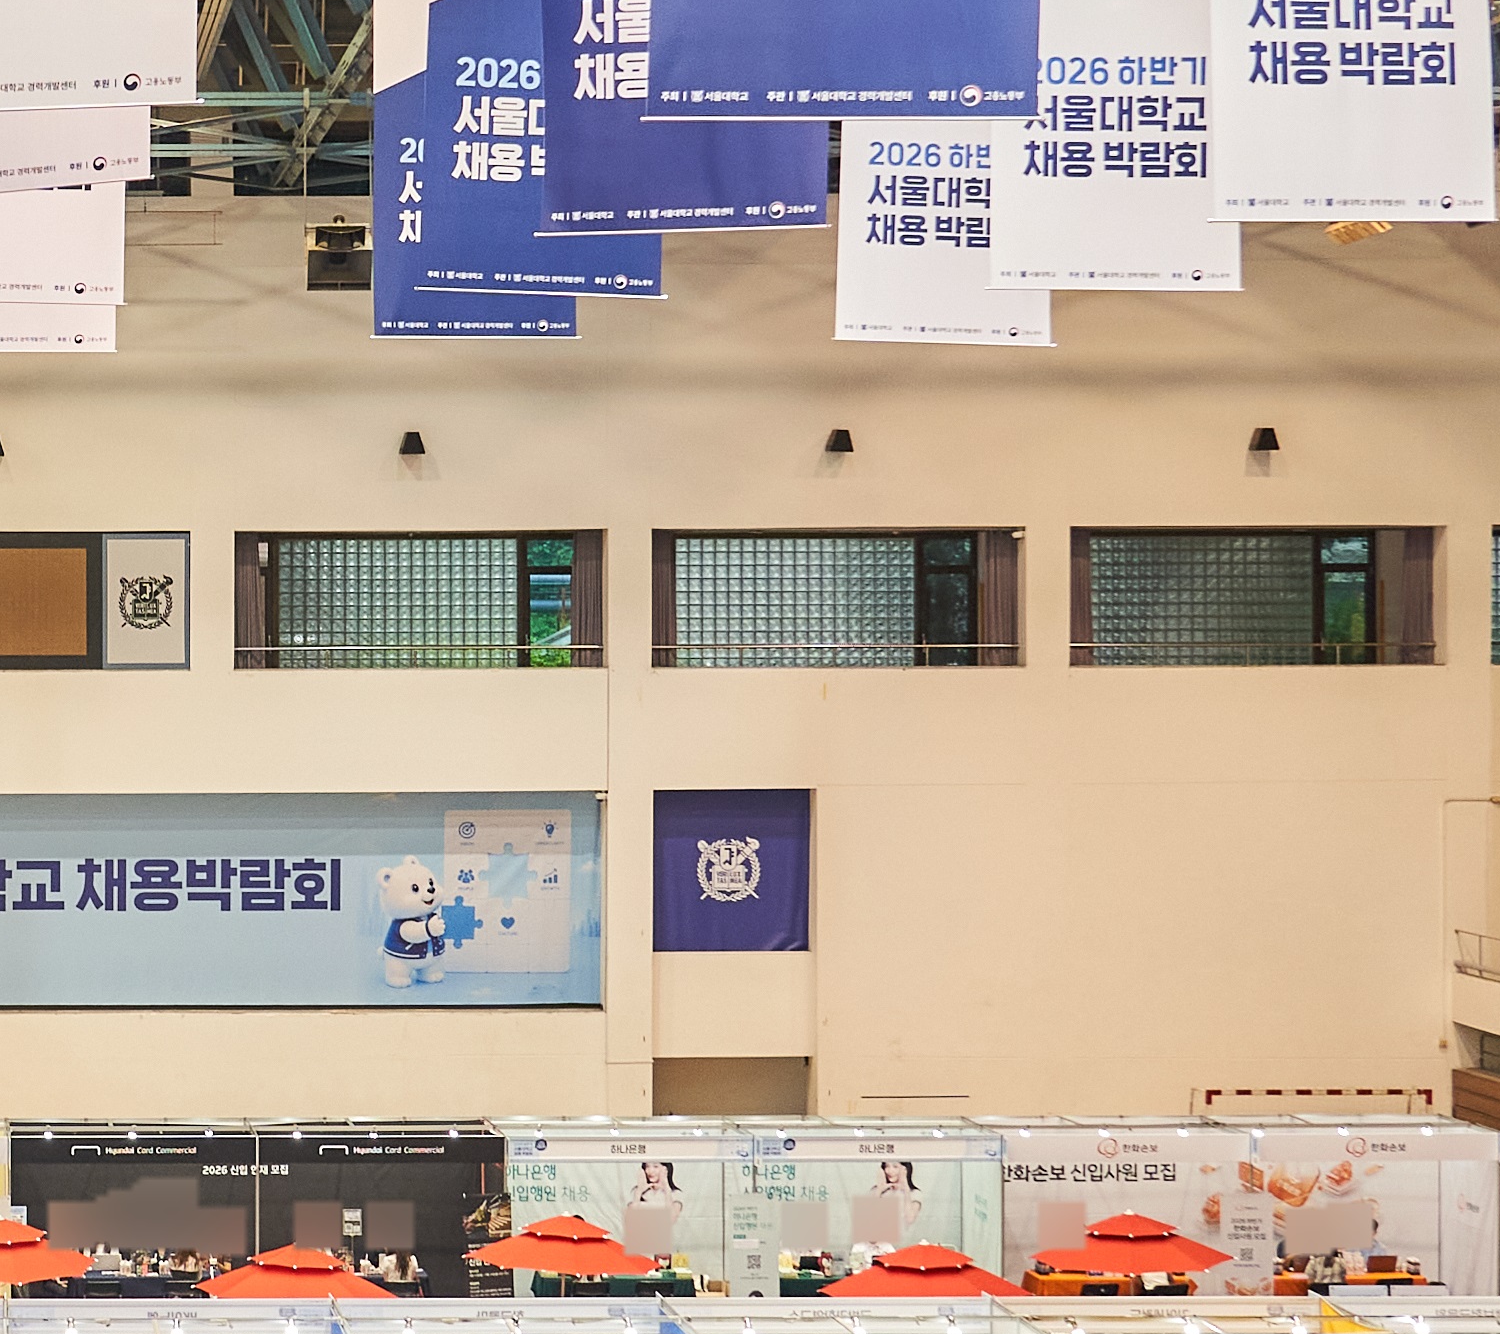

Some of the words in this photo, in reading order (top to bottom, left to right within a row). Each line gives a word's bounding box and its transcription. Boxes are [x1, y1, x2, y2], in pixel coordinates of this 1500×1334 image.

[28, 81, 76, 91] 경력개발센터
[94, 79, 109, 88] 후원
[146, 77, 181, 86] 고용노동부
[76, 858, 341, 911] 채용박람회
[104, 1147, 134, 1155] Hyundai
[138, 1146, 154, 1155] Card
[154, 1147, 196, 1155] Commercial
[611, 1145, 646, 1154] 하나은행
[1071, 1164, 1138, 1182] 신입사원
[1143, 1164, 1176, 1181] 모집
